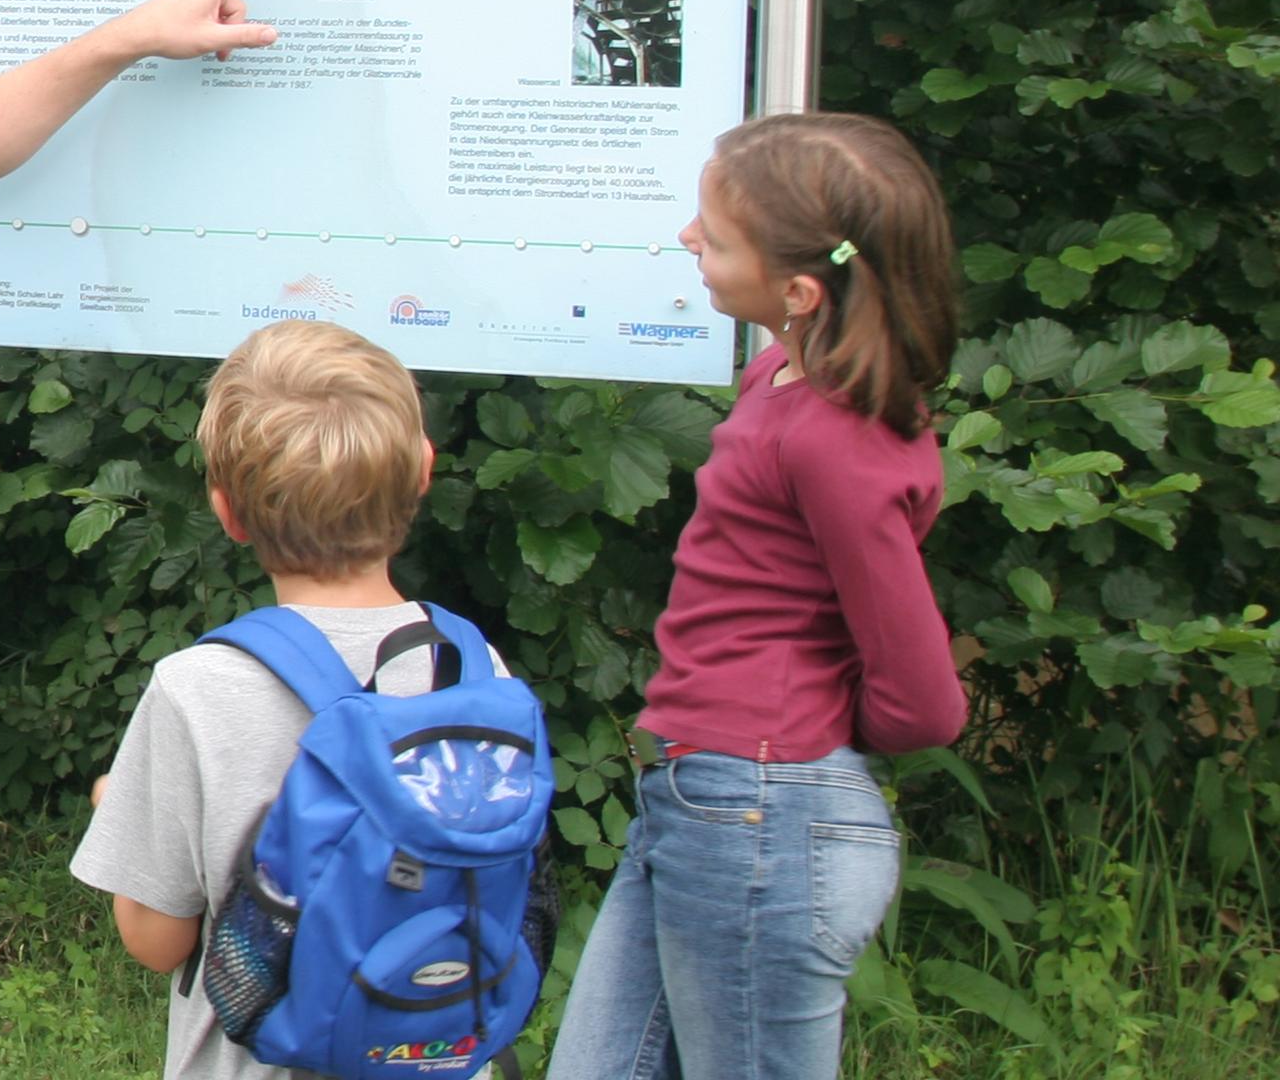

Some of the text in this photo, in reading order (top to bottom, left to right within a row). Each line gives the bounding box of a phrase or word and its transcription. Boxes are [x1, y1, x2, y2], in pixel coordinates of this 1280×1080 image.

[242, 304, 316, 320] badenova
[390, 315, 450, 327] Neubauer
[630, 323, 698, 340] Wagner
